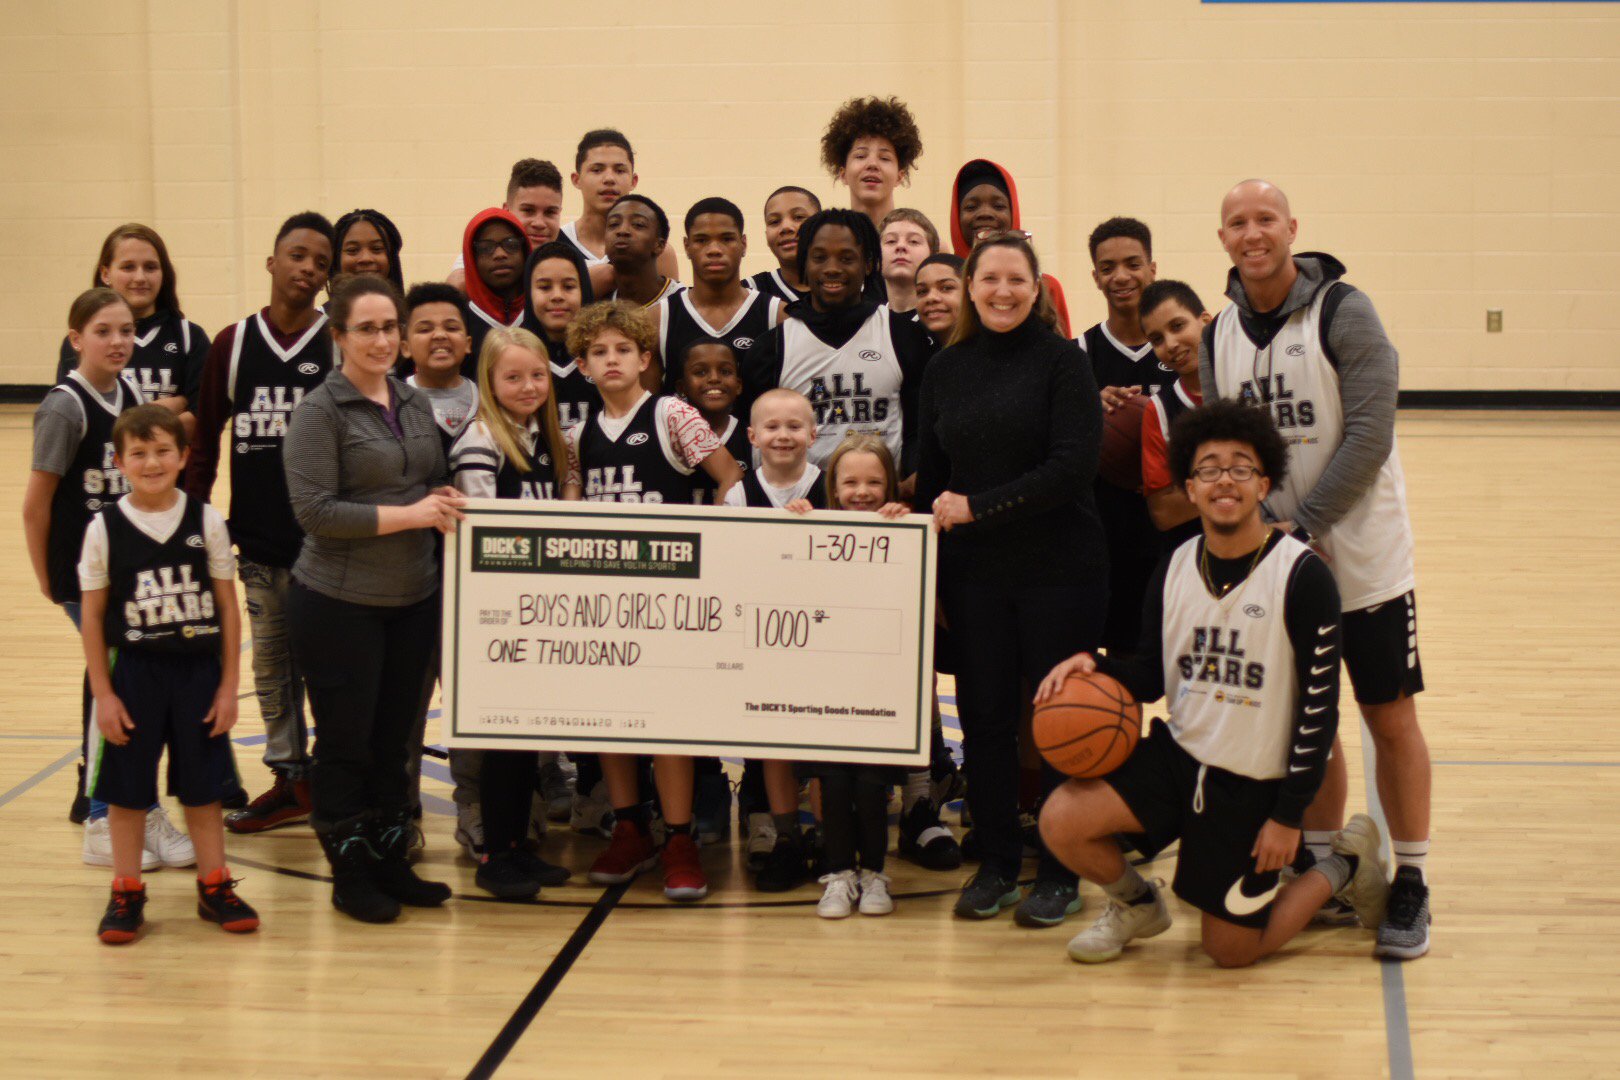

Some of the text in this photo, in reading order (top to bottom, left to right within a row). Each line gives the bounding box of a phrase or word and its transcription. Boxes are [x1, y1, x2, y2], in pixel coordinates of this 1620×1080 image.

[808, 373, 872, 402] ALL
[1238, 373, 1293, 407] ALL
[236, 412, 288, 438] STA
[811, 397, 889, 425] TARS
[586, 465, 642, 496] ALL
[482, 536, 530, 554] DICK'S
[546, 537, 617, 560] SPORTS
[809, 533, 890, 563] 1-30-19
[560, 560, 677, 571] HELPING TO SAVE YOUTH SPORTS
[135, 564, 200, 600] ALL
[125, 590, 214, 627] STARS
[519, 593, 722, 631] BOYS AND GIRLS CLUB
[756, 607, 809, 648] 1000
[487, 638, 641, 666] ONE THOUSAND
[745, 702, 896, 717] The DICK'S Sporting Goods Foundation
